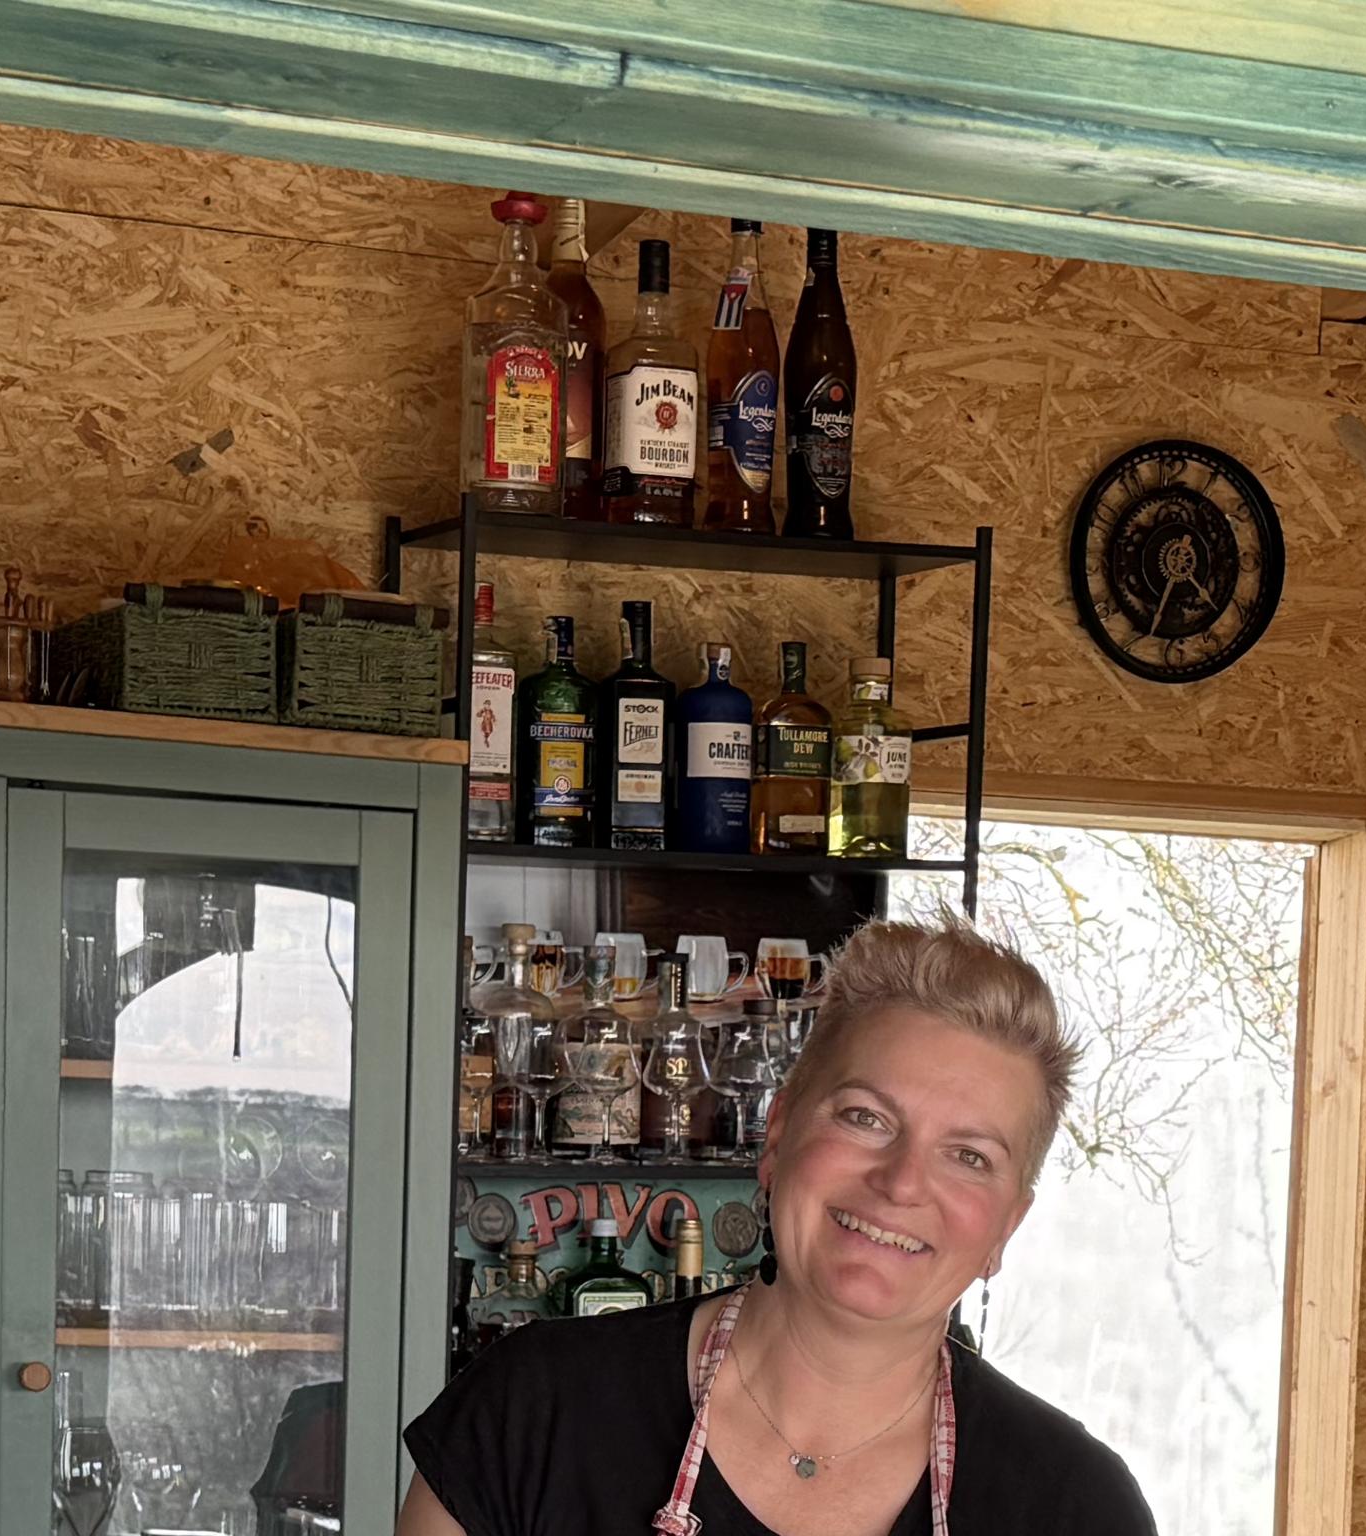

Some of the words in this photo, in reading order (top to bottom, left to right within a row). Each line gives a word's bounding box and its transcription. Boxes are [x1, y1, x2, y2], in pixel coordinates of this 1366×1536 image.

[504, 361, 546, 380] SIERRA
[635, 382, 661, 407] JIM
[663, 379, 695, 411] BEAM
[639, 446, 690, 464] BOURBON
[624, 703, 660, 714] STOCK
[530, 724, 595, 740] BECHEROVKA
[623, 721, 660, 747] FERNET
[777, 726, 829, 743] TULLAMORE
[793, 742, 814, 754] DEW
[885, 750, 908, 765] JUNE
[520, 1181, 700, 1250] PIVO
